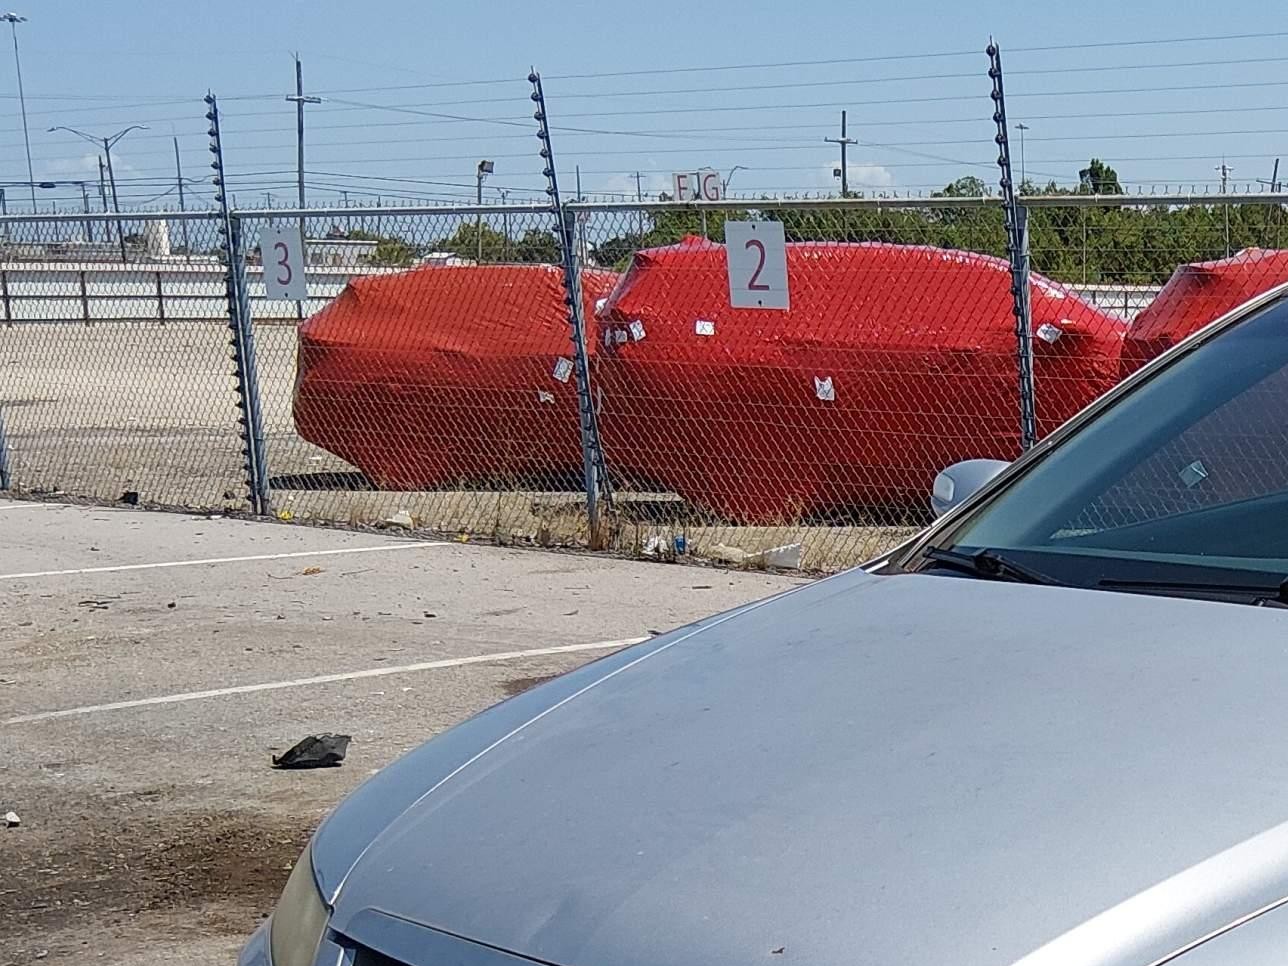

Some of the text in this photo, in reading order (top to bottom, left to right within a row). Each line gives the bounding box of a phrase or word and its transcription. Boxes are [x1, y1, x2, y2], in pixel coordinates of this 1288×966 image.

[677, 174, 688, 200] F
[703, 174, 719, 200] G
[274, 242, 292, 285] 3
[745, 239, 770, 291] 2
